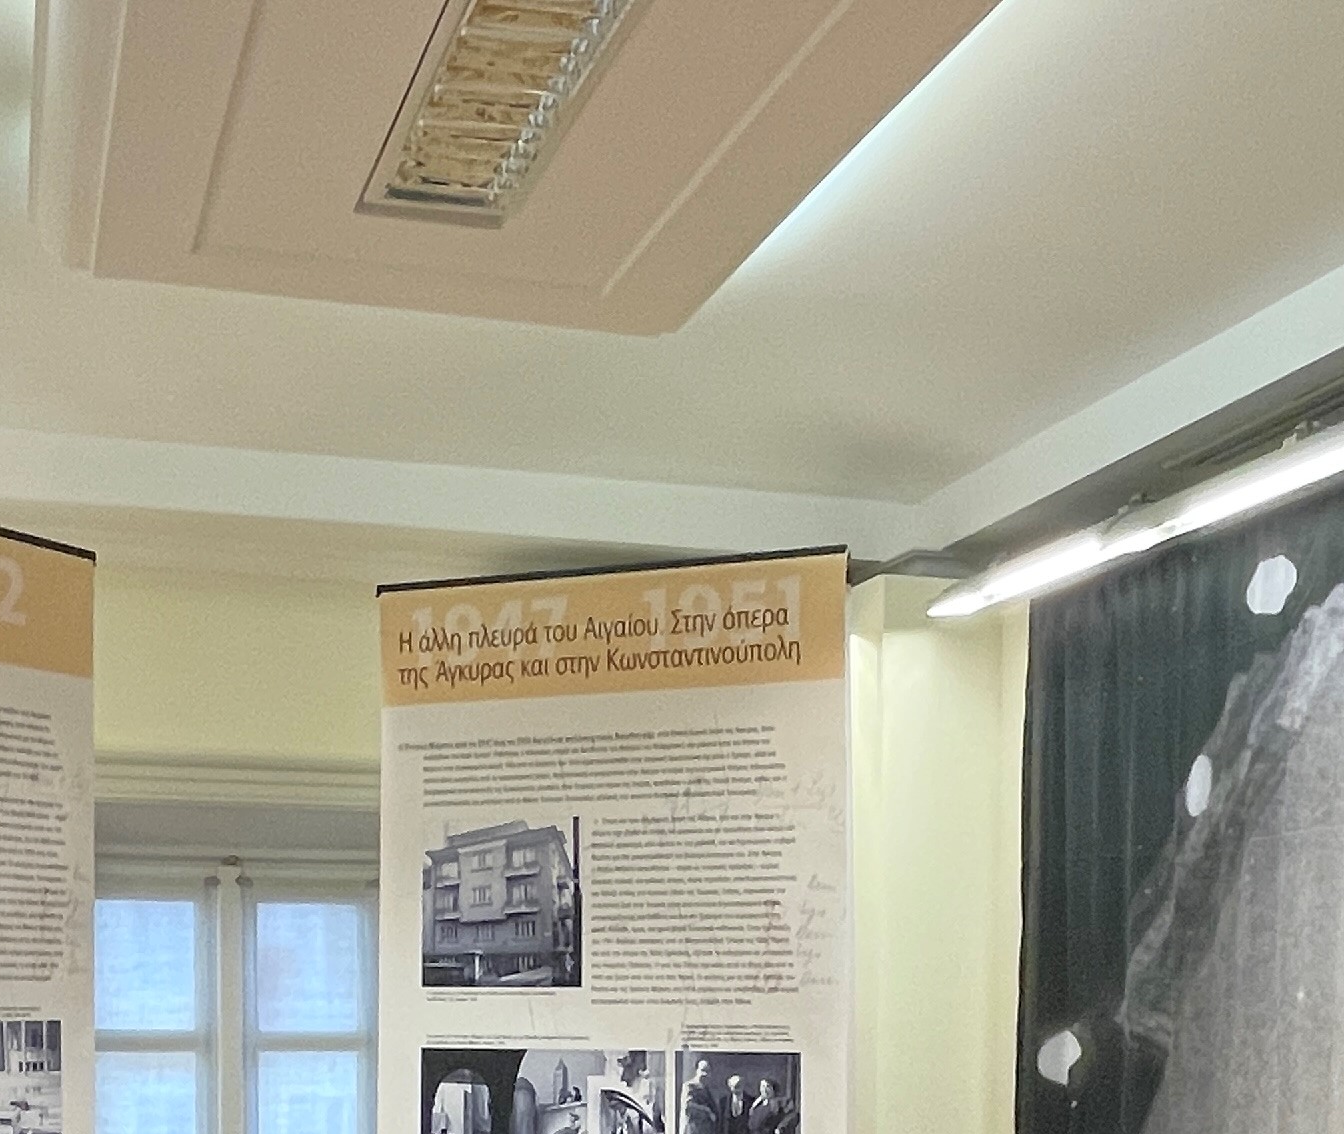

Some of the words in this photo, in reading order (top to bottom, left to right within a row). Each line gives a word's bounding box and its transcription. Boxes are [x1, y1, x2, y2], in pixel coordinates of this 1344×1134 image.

[399, 631, 413, 655] Η
[419, 626, 462, 657] άλλη
[467, 620, 539, 652] πλευρά
[544, 619, 577, 645] του
[670, 606, 717, 643] Στην
[722, 603, 791, 635] όπερα
[412, 596, 568, 668] 1947
[643, 574, 802, 652] 1951
[398, 663, 429, 690] της
[521, 660, 549, 678] και
[554, 652, 599, 680] στην
[606, 636, 803, 675] Κωνσταντινούπολη
